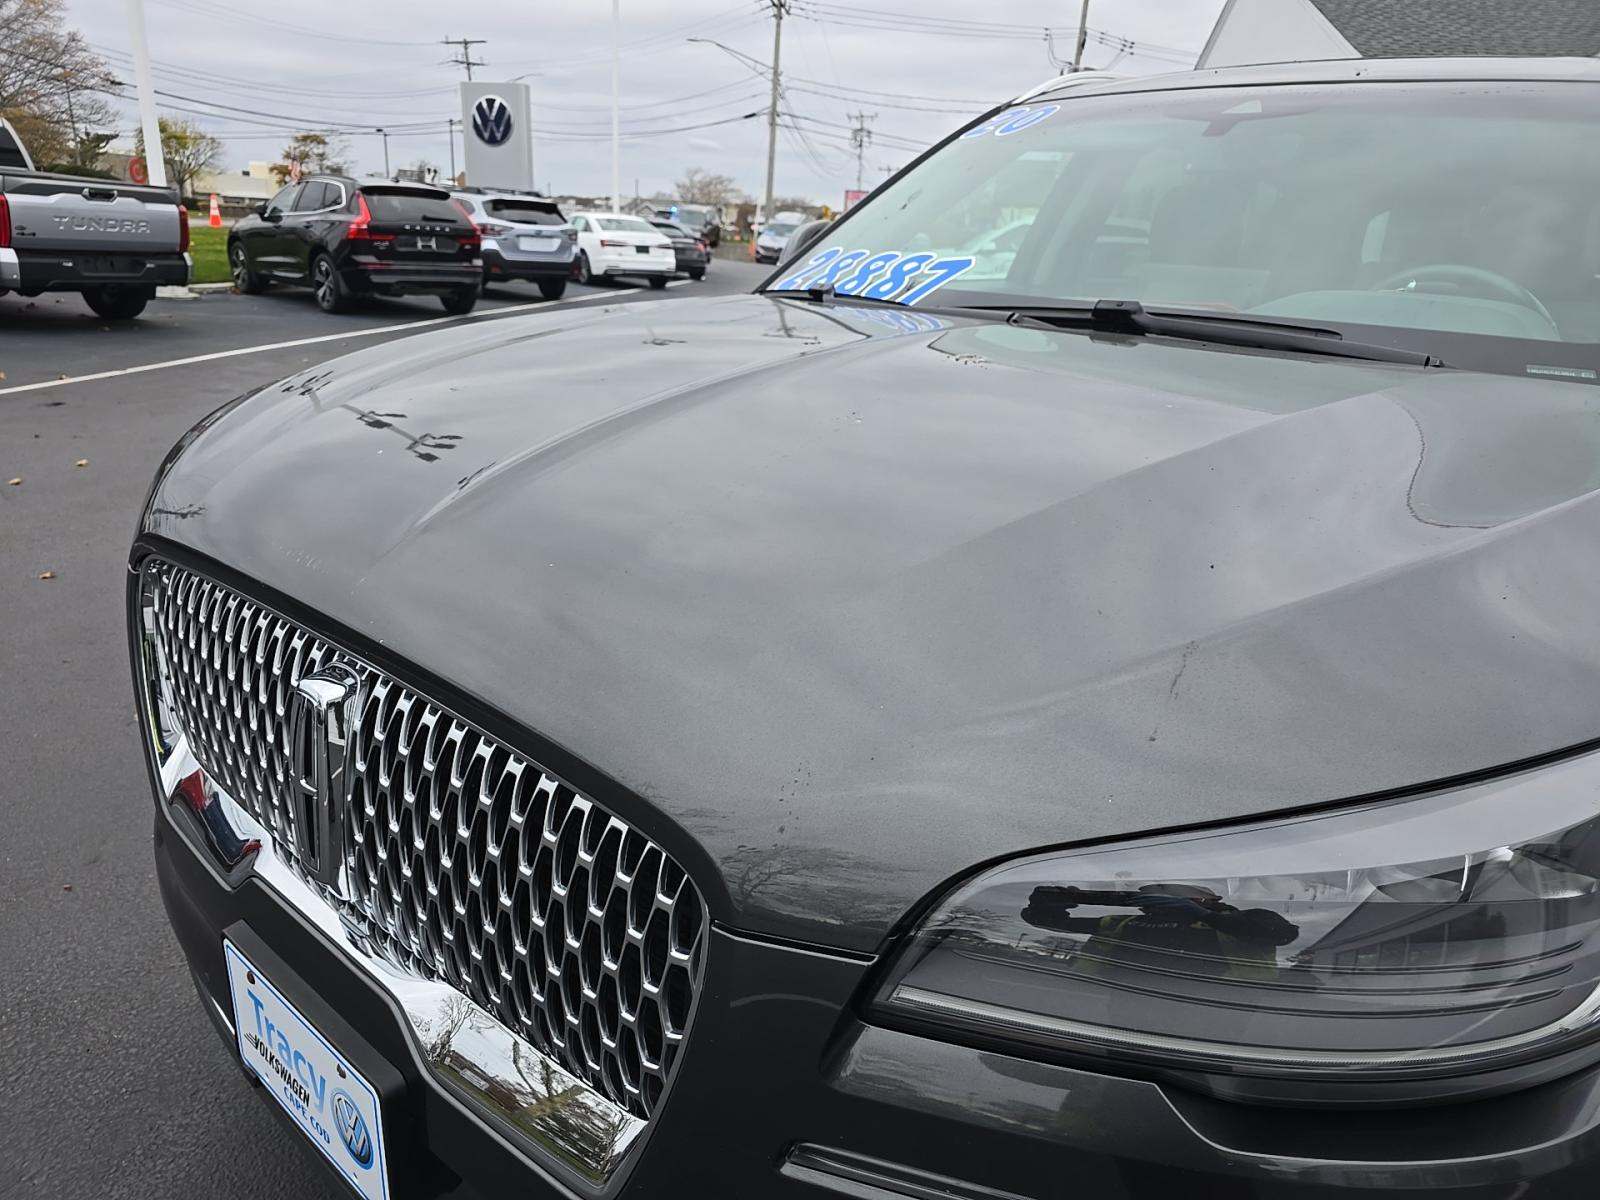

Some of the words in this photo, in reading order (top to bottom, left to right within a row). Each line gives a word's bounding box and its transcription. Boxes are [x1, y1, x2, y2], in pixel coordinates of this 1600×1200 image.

[52, 215, 151, 233] TUNDRA
[766, 247, 976, 306] 28887
[246, 1032, 310, 1107] VOLKSWAGEN
[248, 989, 326, 1114] Tracy
[284, 1086, 308, 1121] CAPE
[310, 1116, 331, 1144] COD
